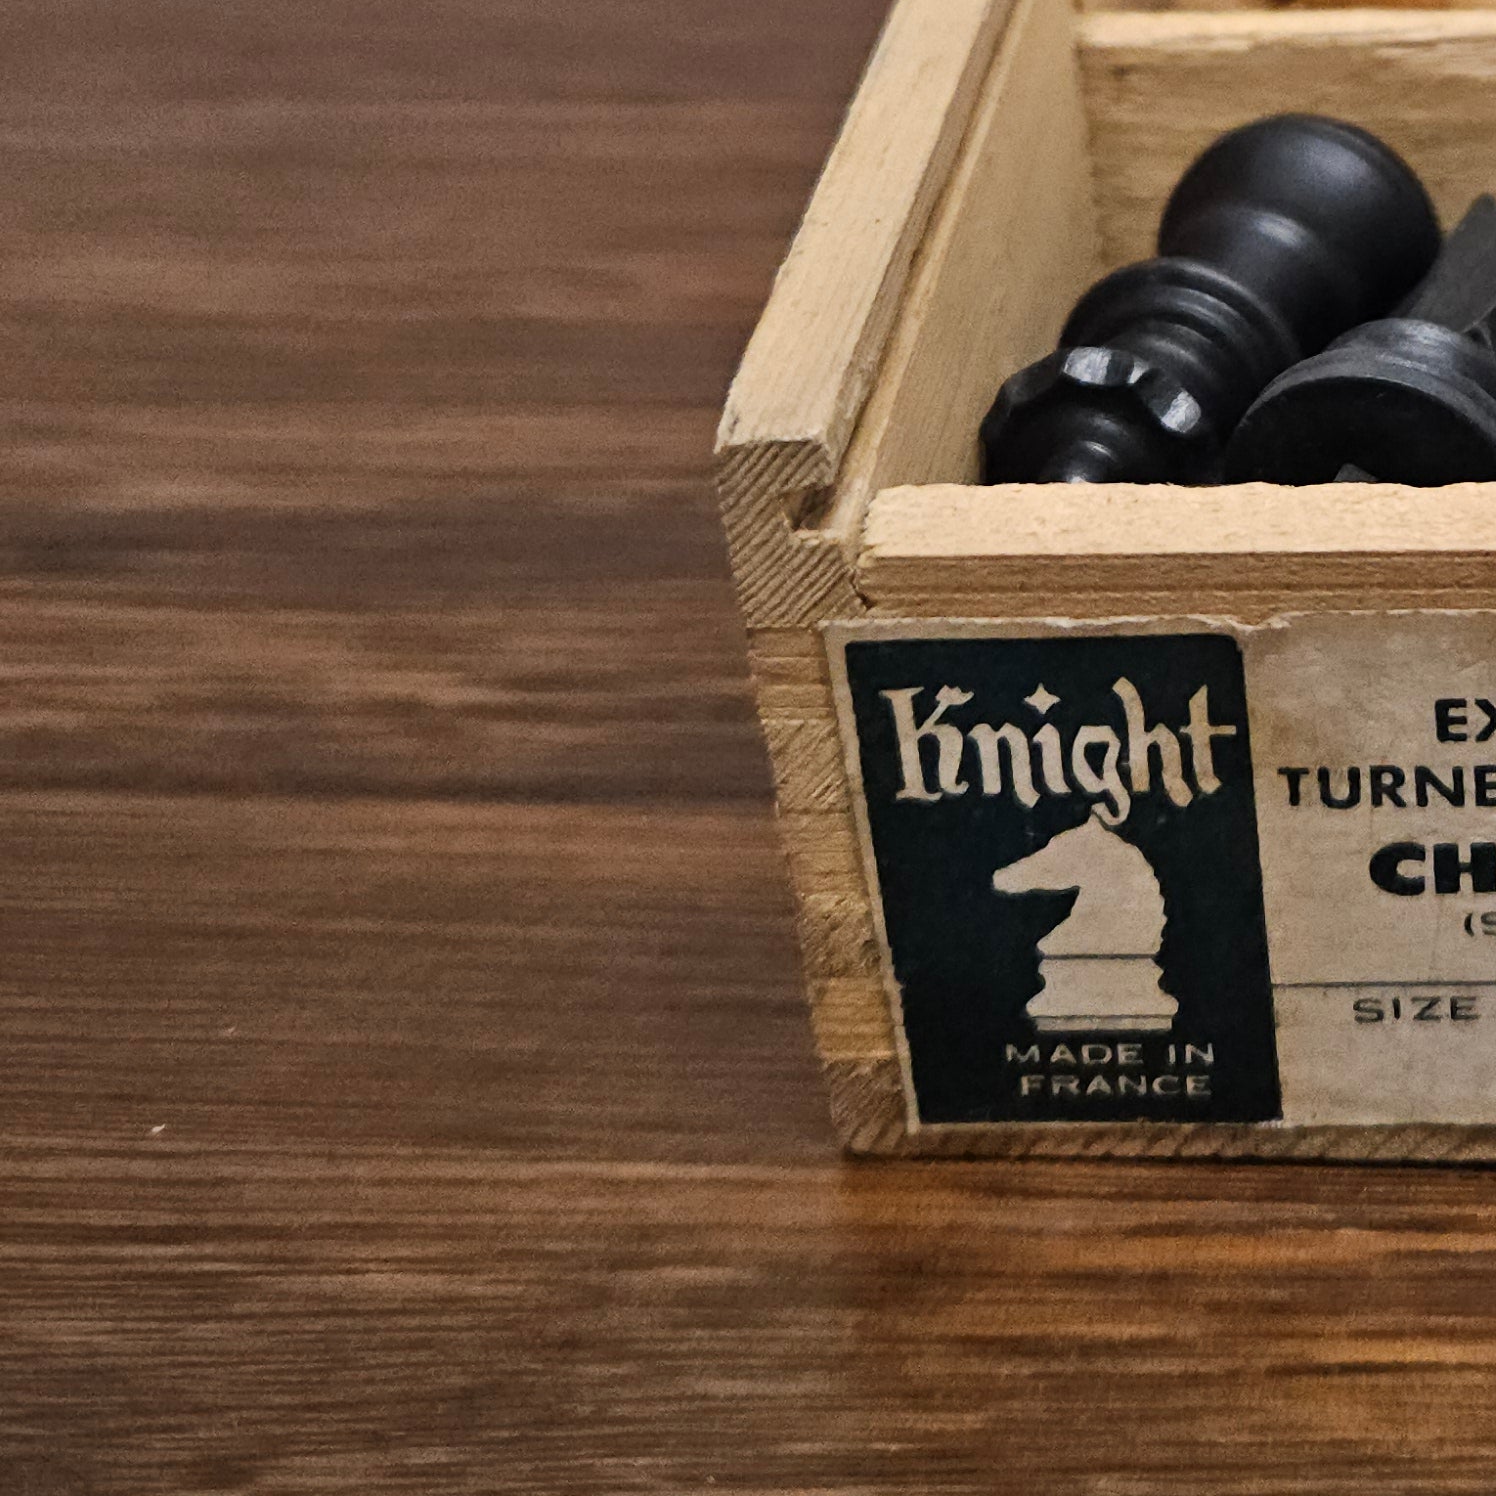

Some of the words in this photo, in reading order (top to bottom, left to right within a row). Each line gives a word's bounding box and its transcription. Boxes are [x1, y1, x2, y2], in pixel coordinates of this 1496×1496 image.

[879, 676, 1237, 826] Knight
[1352, 993, 1481, 1024] SIZE
[1005, 1041, 1144, 1066] MADE
[1166, 1041, 1215, 1065] IN
[1018, 1073, 1213, 1098] FRANCE
